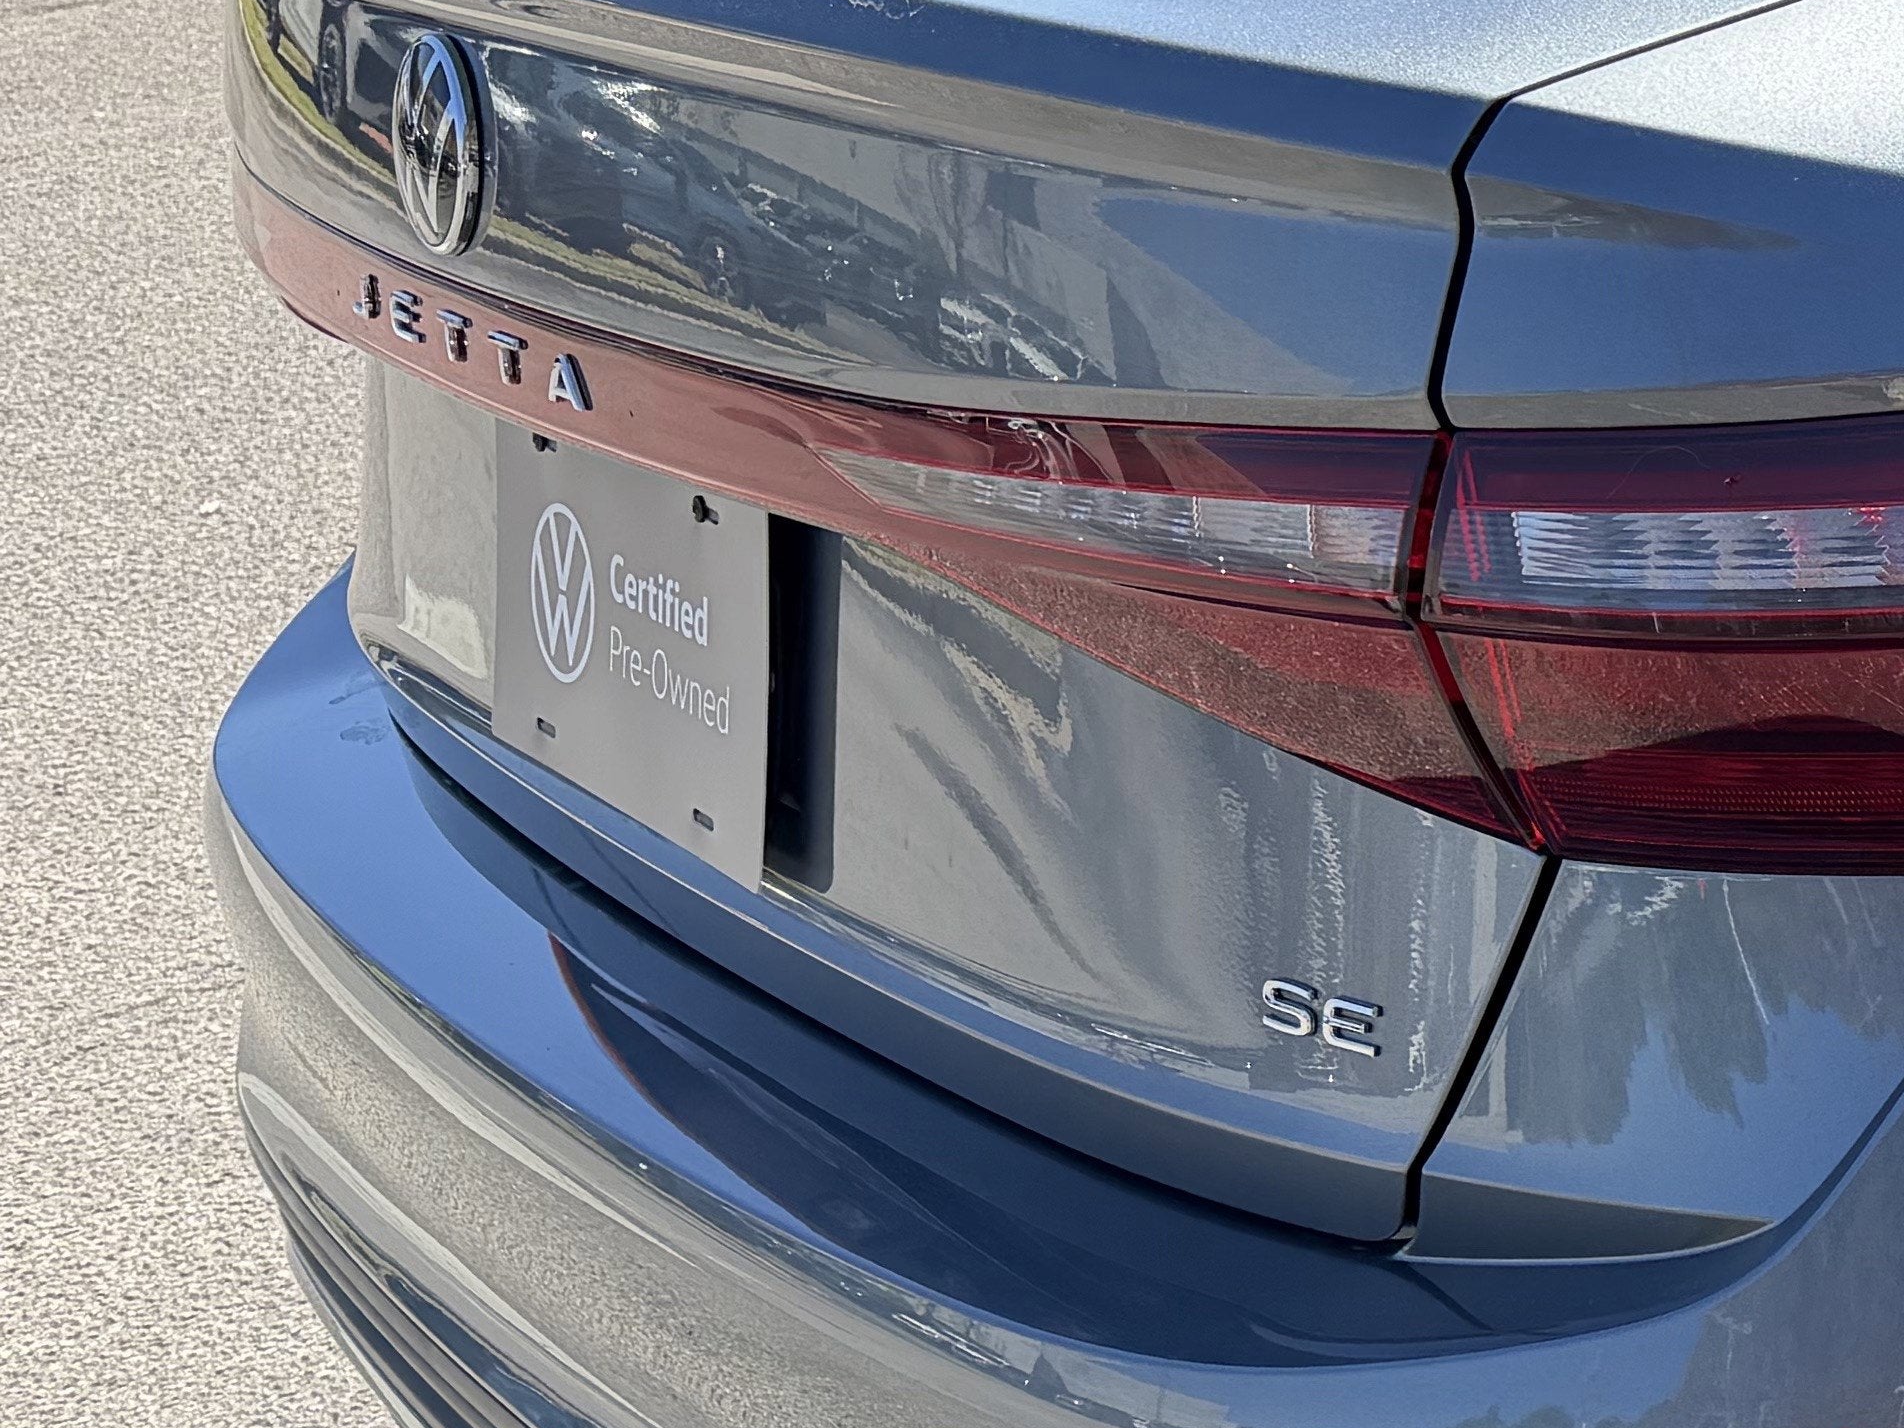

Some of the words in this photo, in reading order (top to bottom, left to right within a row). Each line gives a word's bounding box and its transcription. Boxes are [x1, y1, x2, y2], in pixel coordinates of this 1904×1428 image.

[353, 273, 594, 412] JETTA
[609, 553, 710, 647] Certified
[609, 625, 730, 736] Pre-Owned
[1263, 977, 1384, 1058] SE
